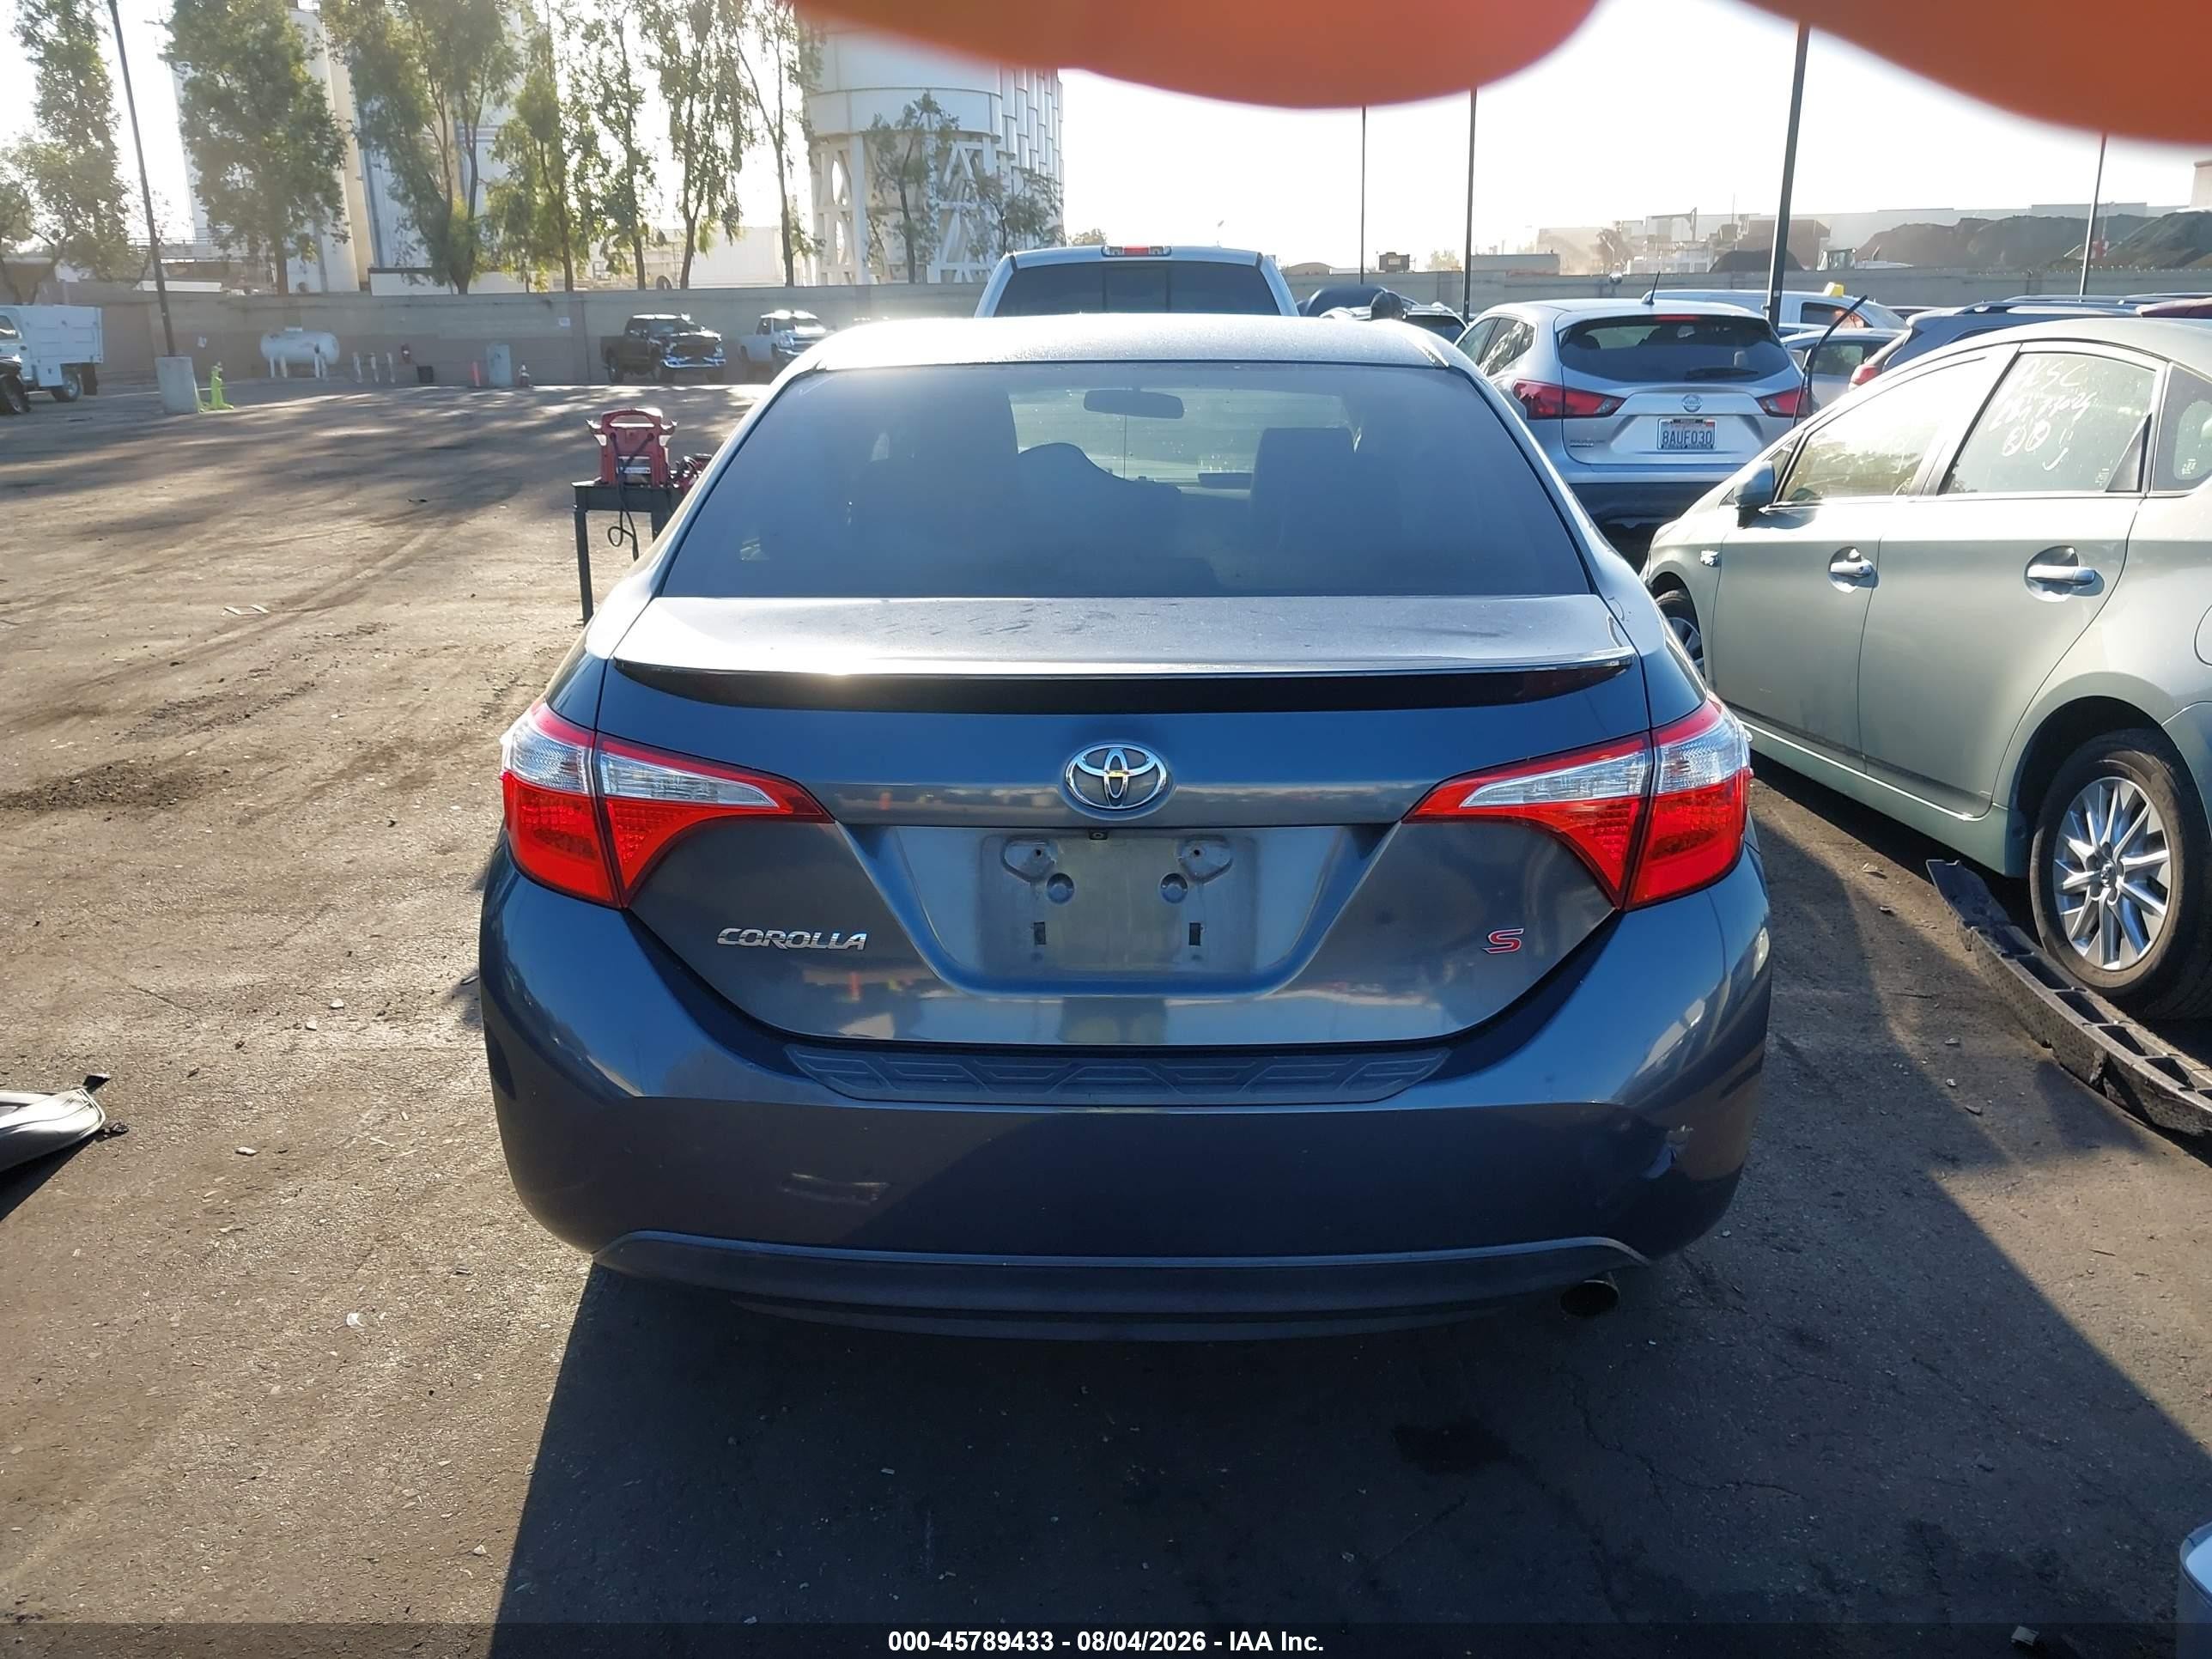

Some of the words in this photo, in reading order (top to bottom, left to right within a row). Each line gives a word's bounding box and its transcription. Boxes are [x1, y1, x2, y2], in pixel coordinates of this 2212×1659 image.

[1662, 430, 1713, 445] 8AUF030
[717, 927, 867, 951] COROLLA
[1481, 927, 1525, 954] S
